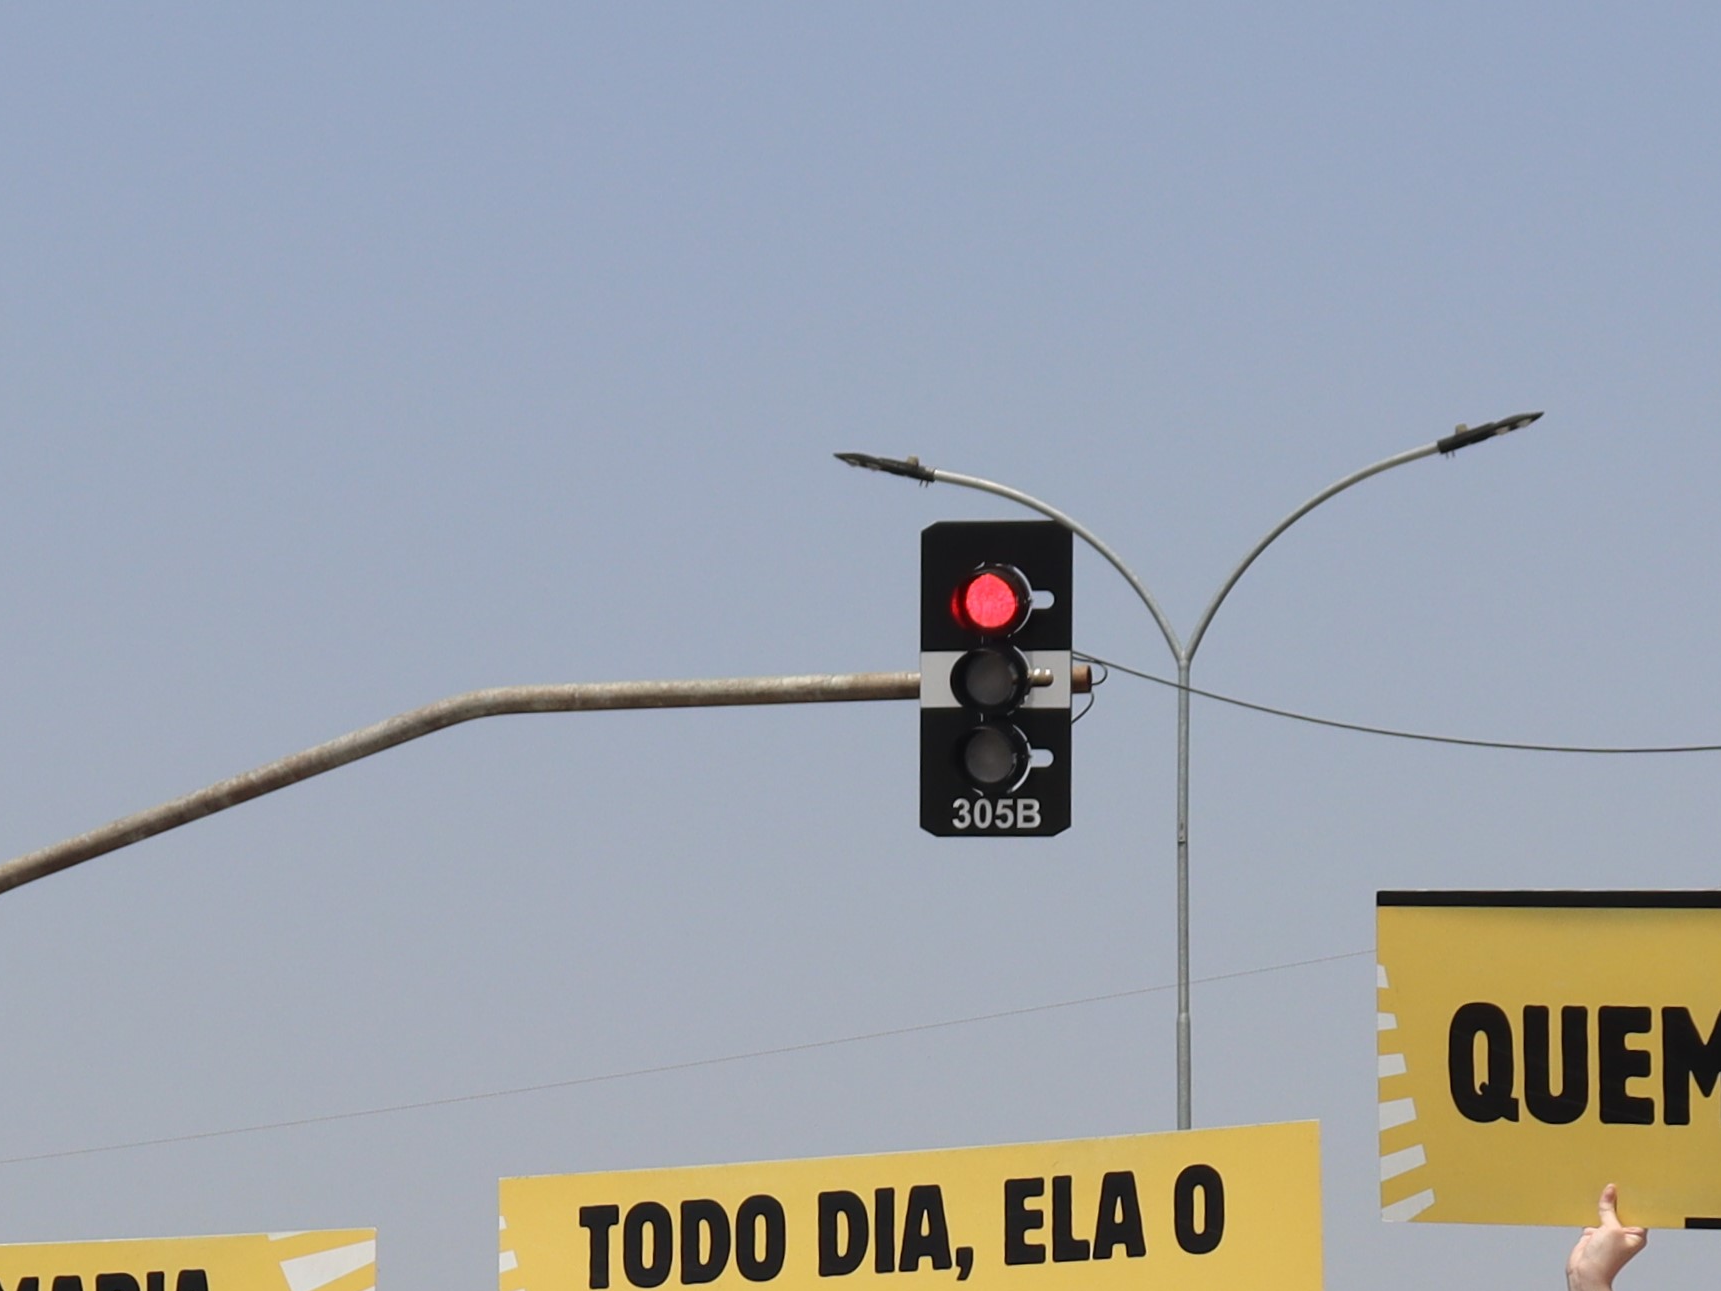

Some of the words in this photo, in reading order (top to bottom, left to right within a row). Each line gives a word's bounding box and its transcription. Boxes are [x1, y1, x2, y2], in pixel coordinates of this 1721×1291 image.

[952, 798, 1041, 829] 305B
[580, 1195, 786, 1290] TODO
[818, 1185, 974, 1281] DIA,
[1005, 1171, 1147, 1266] ELA
[1174, 1164, 1225, 1255] O
